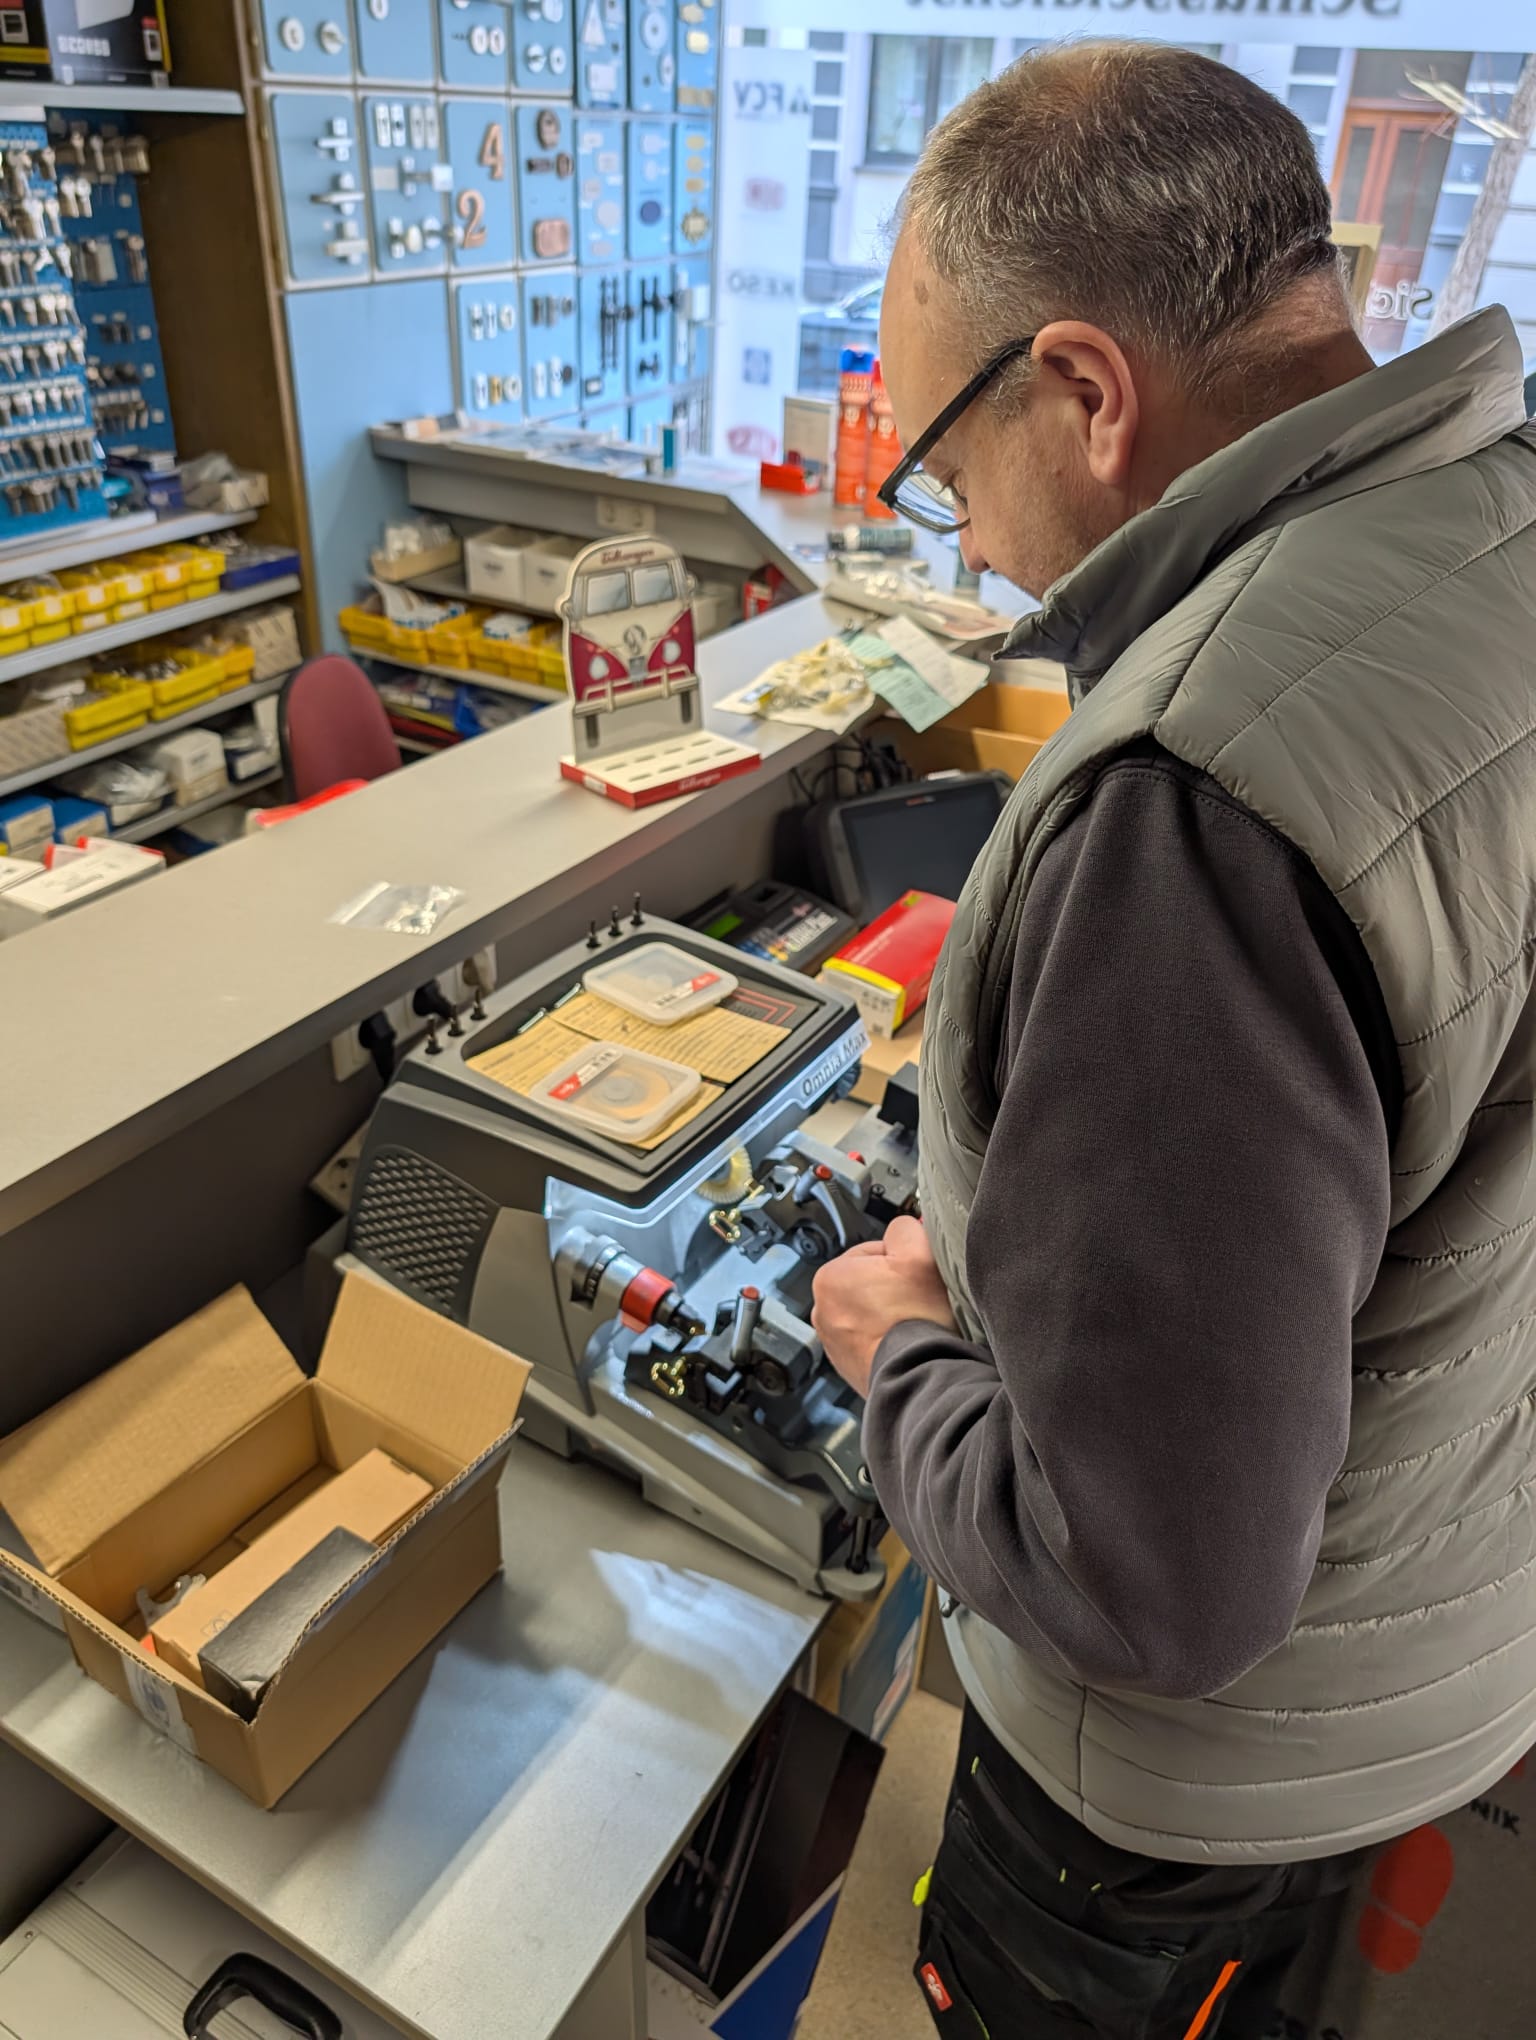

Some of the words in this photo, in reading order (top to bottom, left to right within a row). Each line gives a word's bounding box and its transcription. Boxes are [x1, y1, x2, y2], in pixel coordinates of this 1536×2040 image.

[478, 121, 504, 180] 4
[457, 188, 487, 249] 2
[802, 1054, 841, 1098] Omnia
[843, 1032, 867, 1059] Max
[1470, 1798, 1521, 1837] NIK
